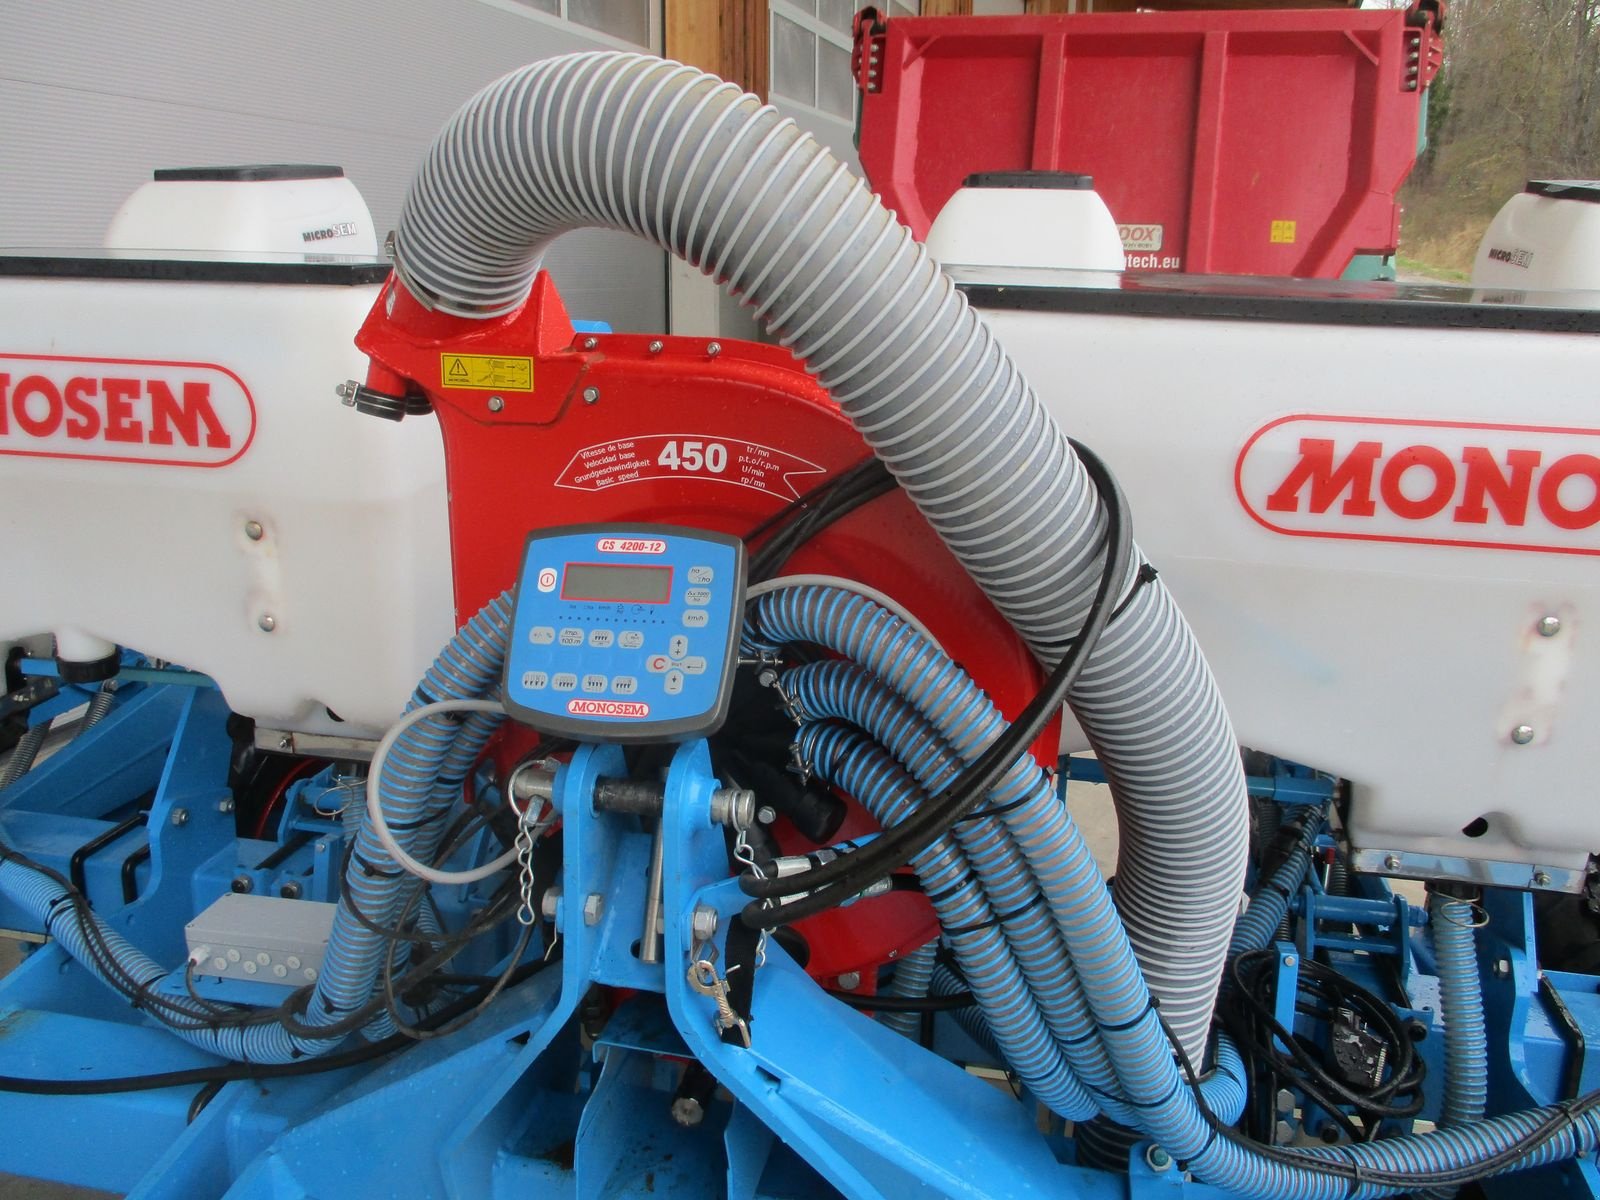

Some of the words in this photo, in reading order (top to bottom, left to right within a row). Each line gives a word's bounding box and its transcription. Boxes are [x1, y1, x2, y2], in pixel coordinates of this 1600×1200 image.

[302, 223, 357, 242] MICROSEM
[1125, 254, 1180, 268] tech.eu
[0, 373, 231, 449] OSEM
[580, 447, 606, 460] Vitesse
[607, 444, 616, 453] de
[618, 441, 635, 451] base
[657, 440, 728, 473] 450
[746, 445, 770, 458] tr/mn
[583, 454, 617, 469] Velocidad
[619, 452, 636, 460] base
[574, 459, 651, 484] Grundgeschwindigkeit
[595, 476, 615, 487] Basic
[617, 470, 639, 482] speed
[741, 465, 765, 478] U/min
[740, 476, 766, 489] rp/mn
[602, 540, 616, 550] CS
[620, 541, 662, 552] 4200-12
[653, 657, 666, 670] C
[571, 701, 645, 717] MONOSEM
